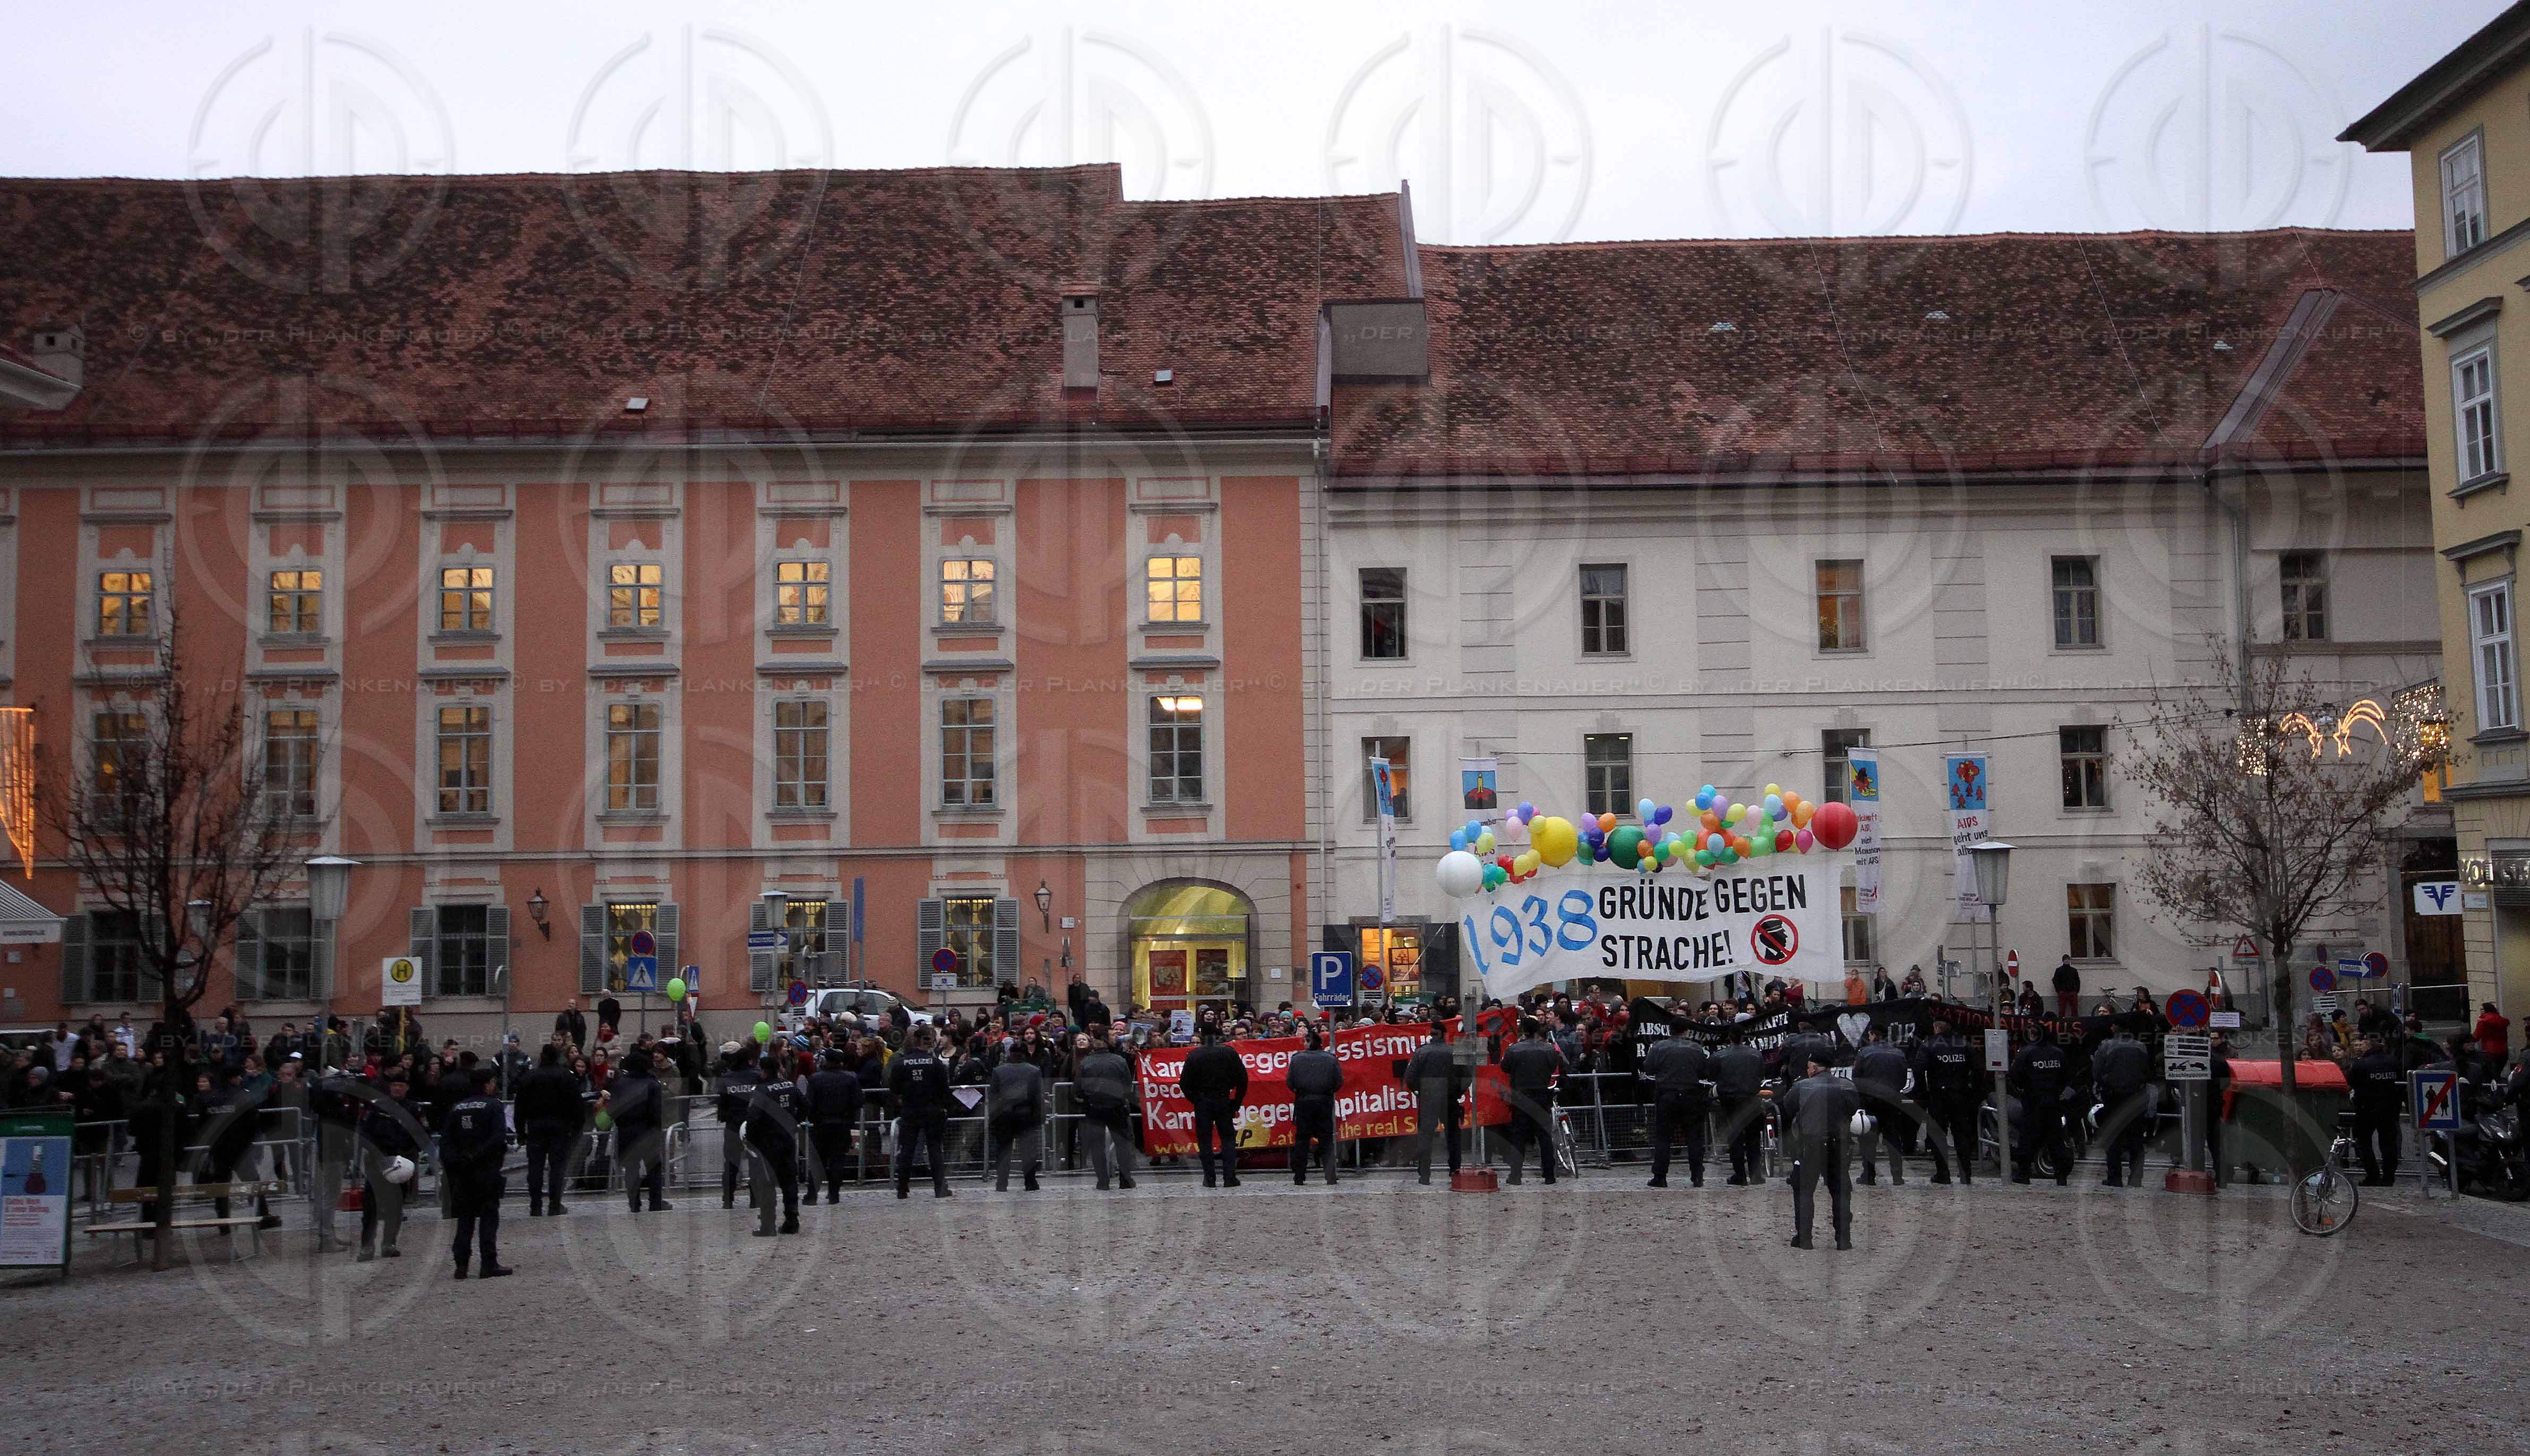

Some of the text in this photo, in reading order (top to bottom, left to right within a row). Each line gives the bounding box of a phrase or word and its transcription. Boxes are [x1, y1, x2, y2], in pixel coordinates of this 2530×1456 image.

[1958, 816, 1978, 829] AIDS
[1953, 829, 1988, 845] geht uns
[1464, 874, 1807, 975] 1938 GRÜNDE GEGEN
[1601, 929, 1734, 970] STRACHE!
[1321, 956, 1343, 990] P
[1314, 992, 1350, 1001] Fahrräder
[1937, 1054, 1965, 1063] POLIZEI
[2032, 1060, 2061, 1068] POLIZEI
[1339, 1121, 1362, 1138] the
[1366, 1116, 1398, 1135] real
